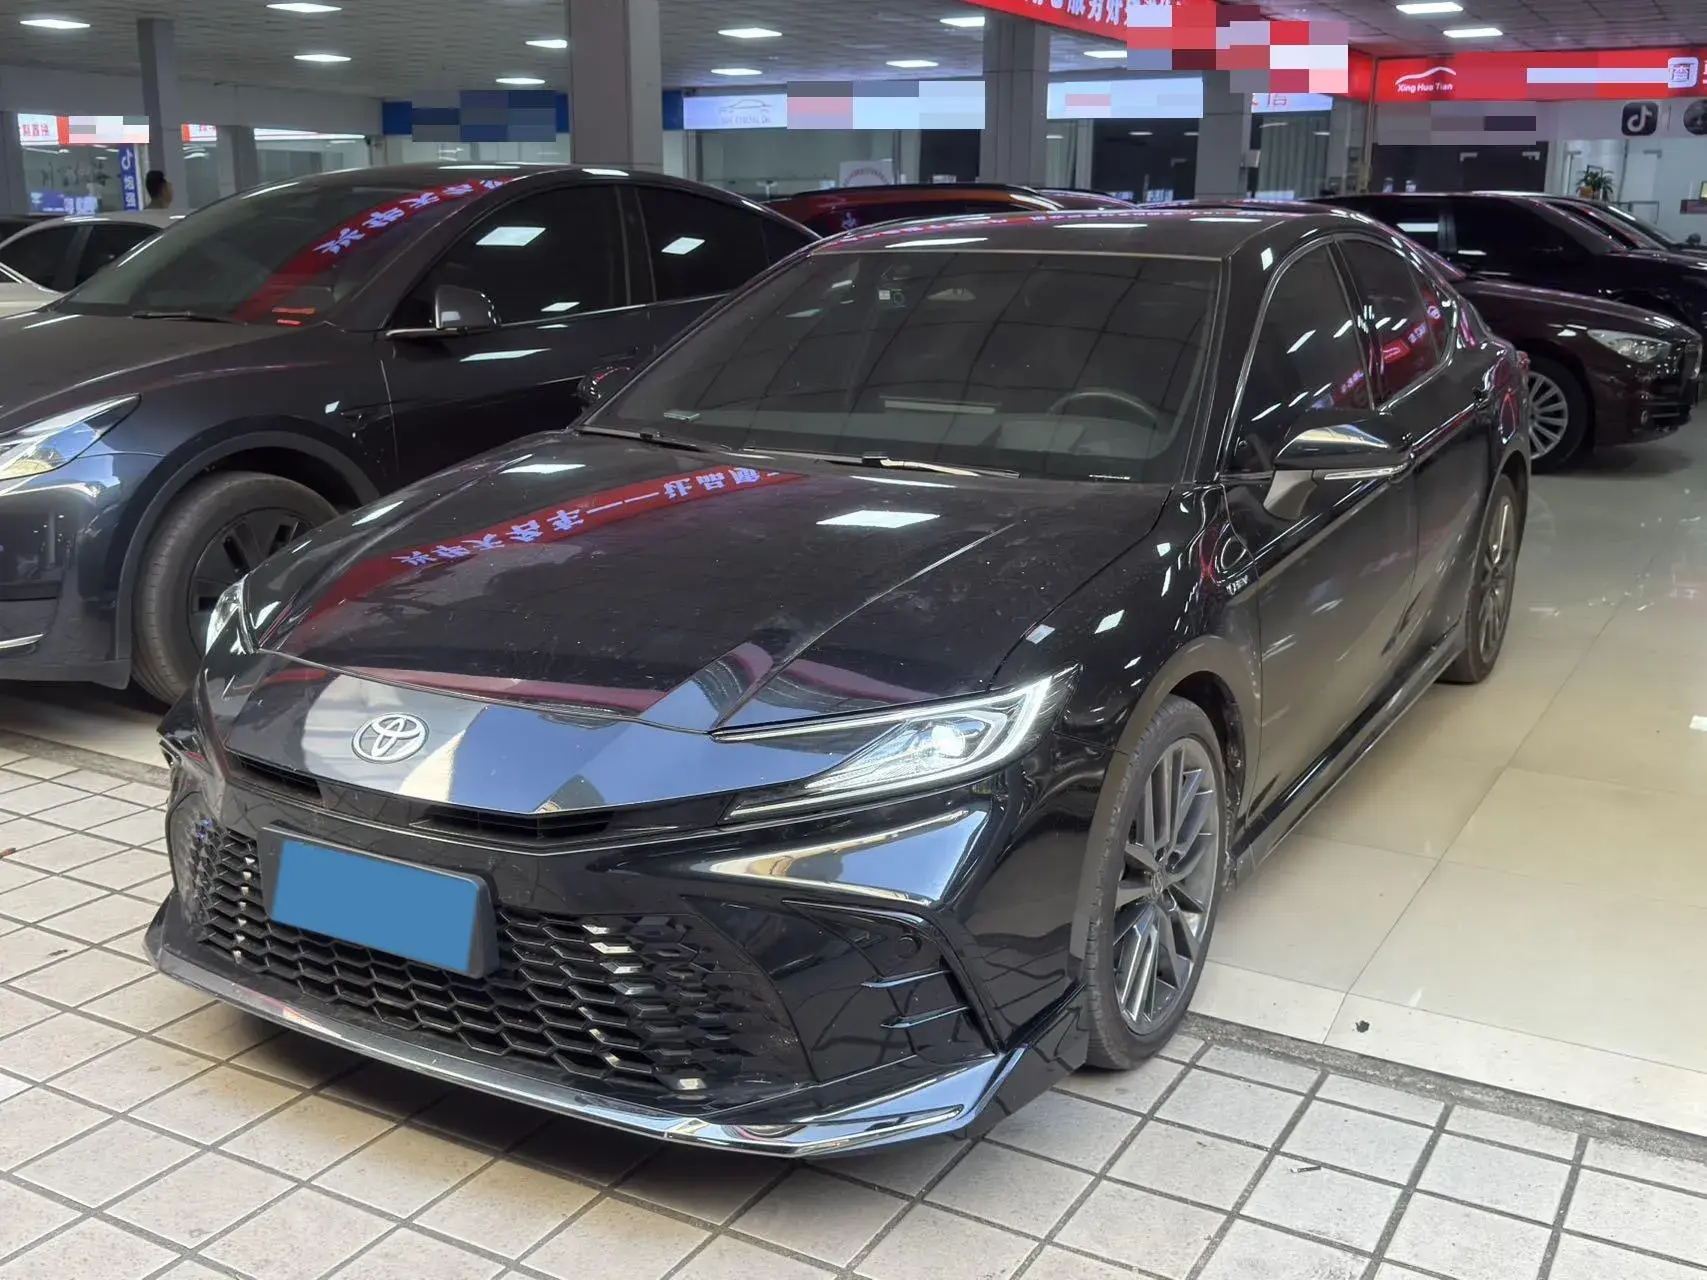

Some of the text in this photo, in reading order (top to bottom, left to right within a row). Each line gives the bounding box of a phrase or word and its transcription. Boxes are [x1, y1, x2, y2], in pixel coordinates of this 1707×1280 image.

[1397, 82, 1453, 94] Xing Hua Tian
